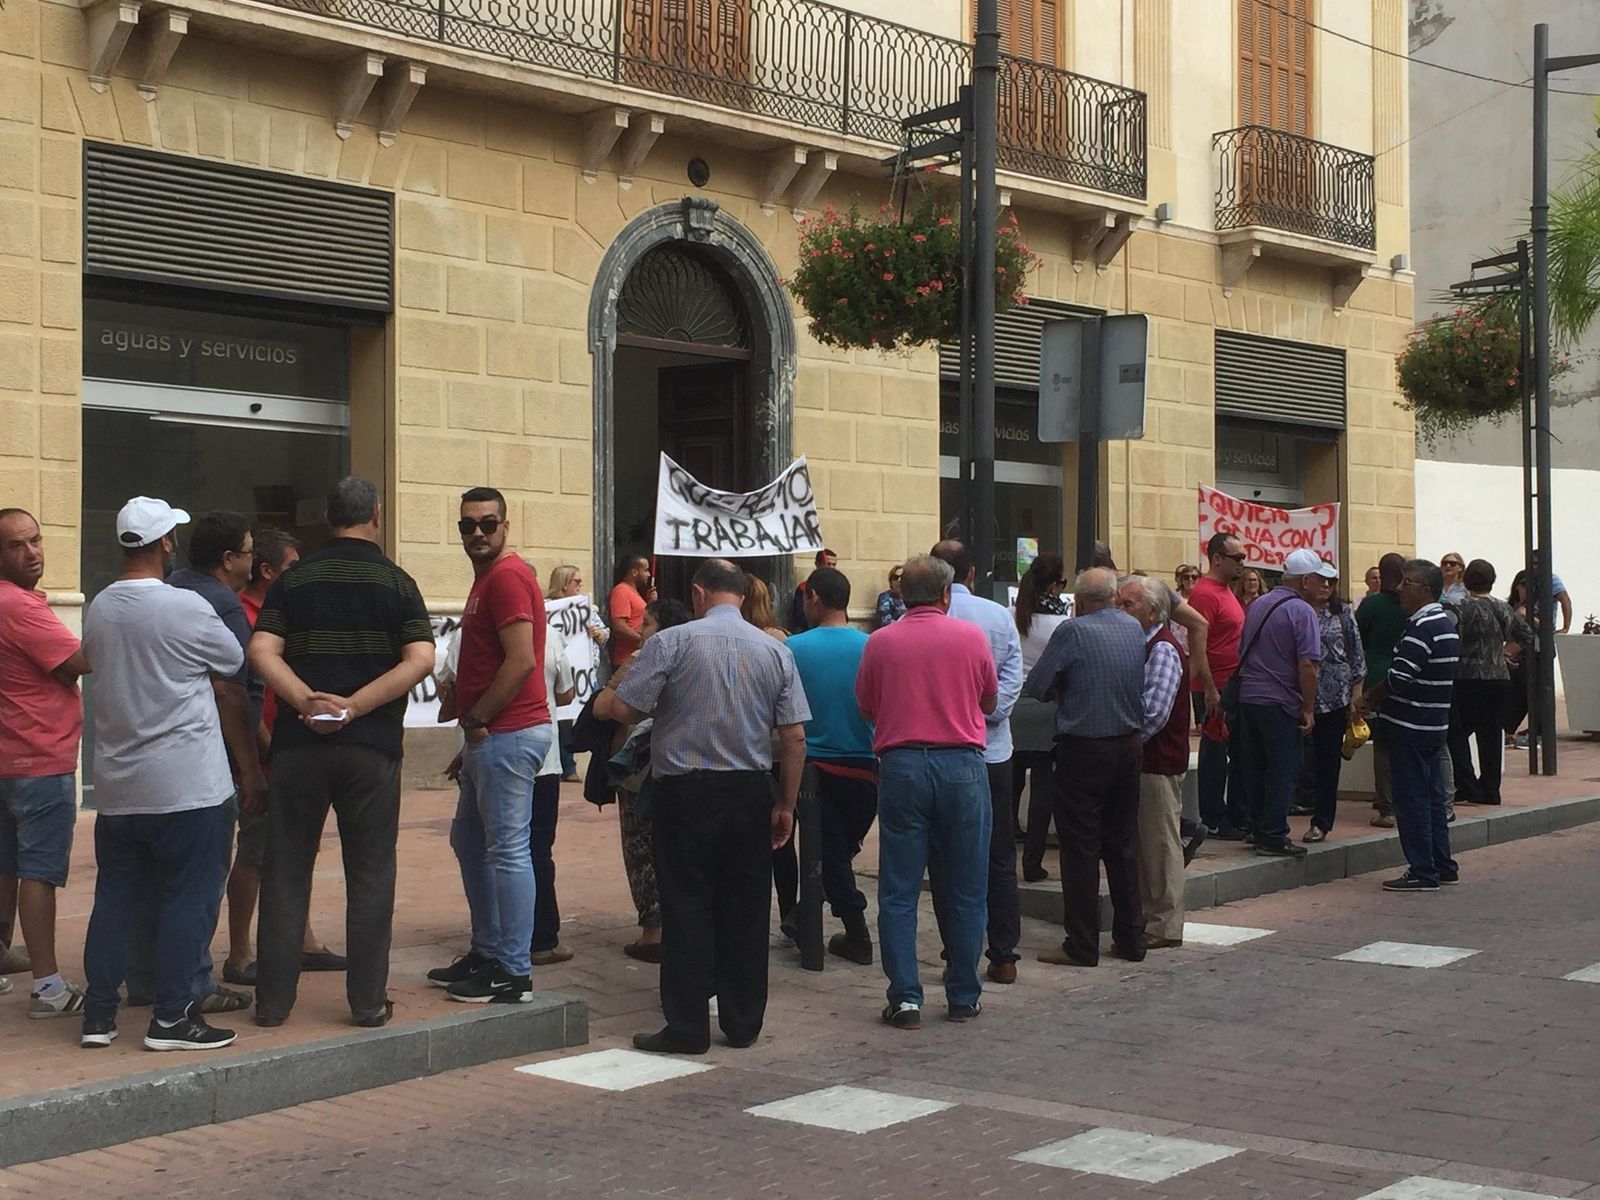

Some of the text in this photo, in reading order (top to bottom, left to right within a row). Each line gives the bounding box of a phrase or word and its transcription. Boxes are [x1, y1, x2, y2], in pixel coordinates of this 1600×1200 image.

[101, 328, 297, 364] aguas y servicios
[665, 510, 822, 553] TRABAJAR
[1278, 527, 1318, 549] CON
